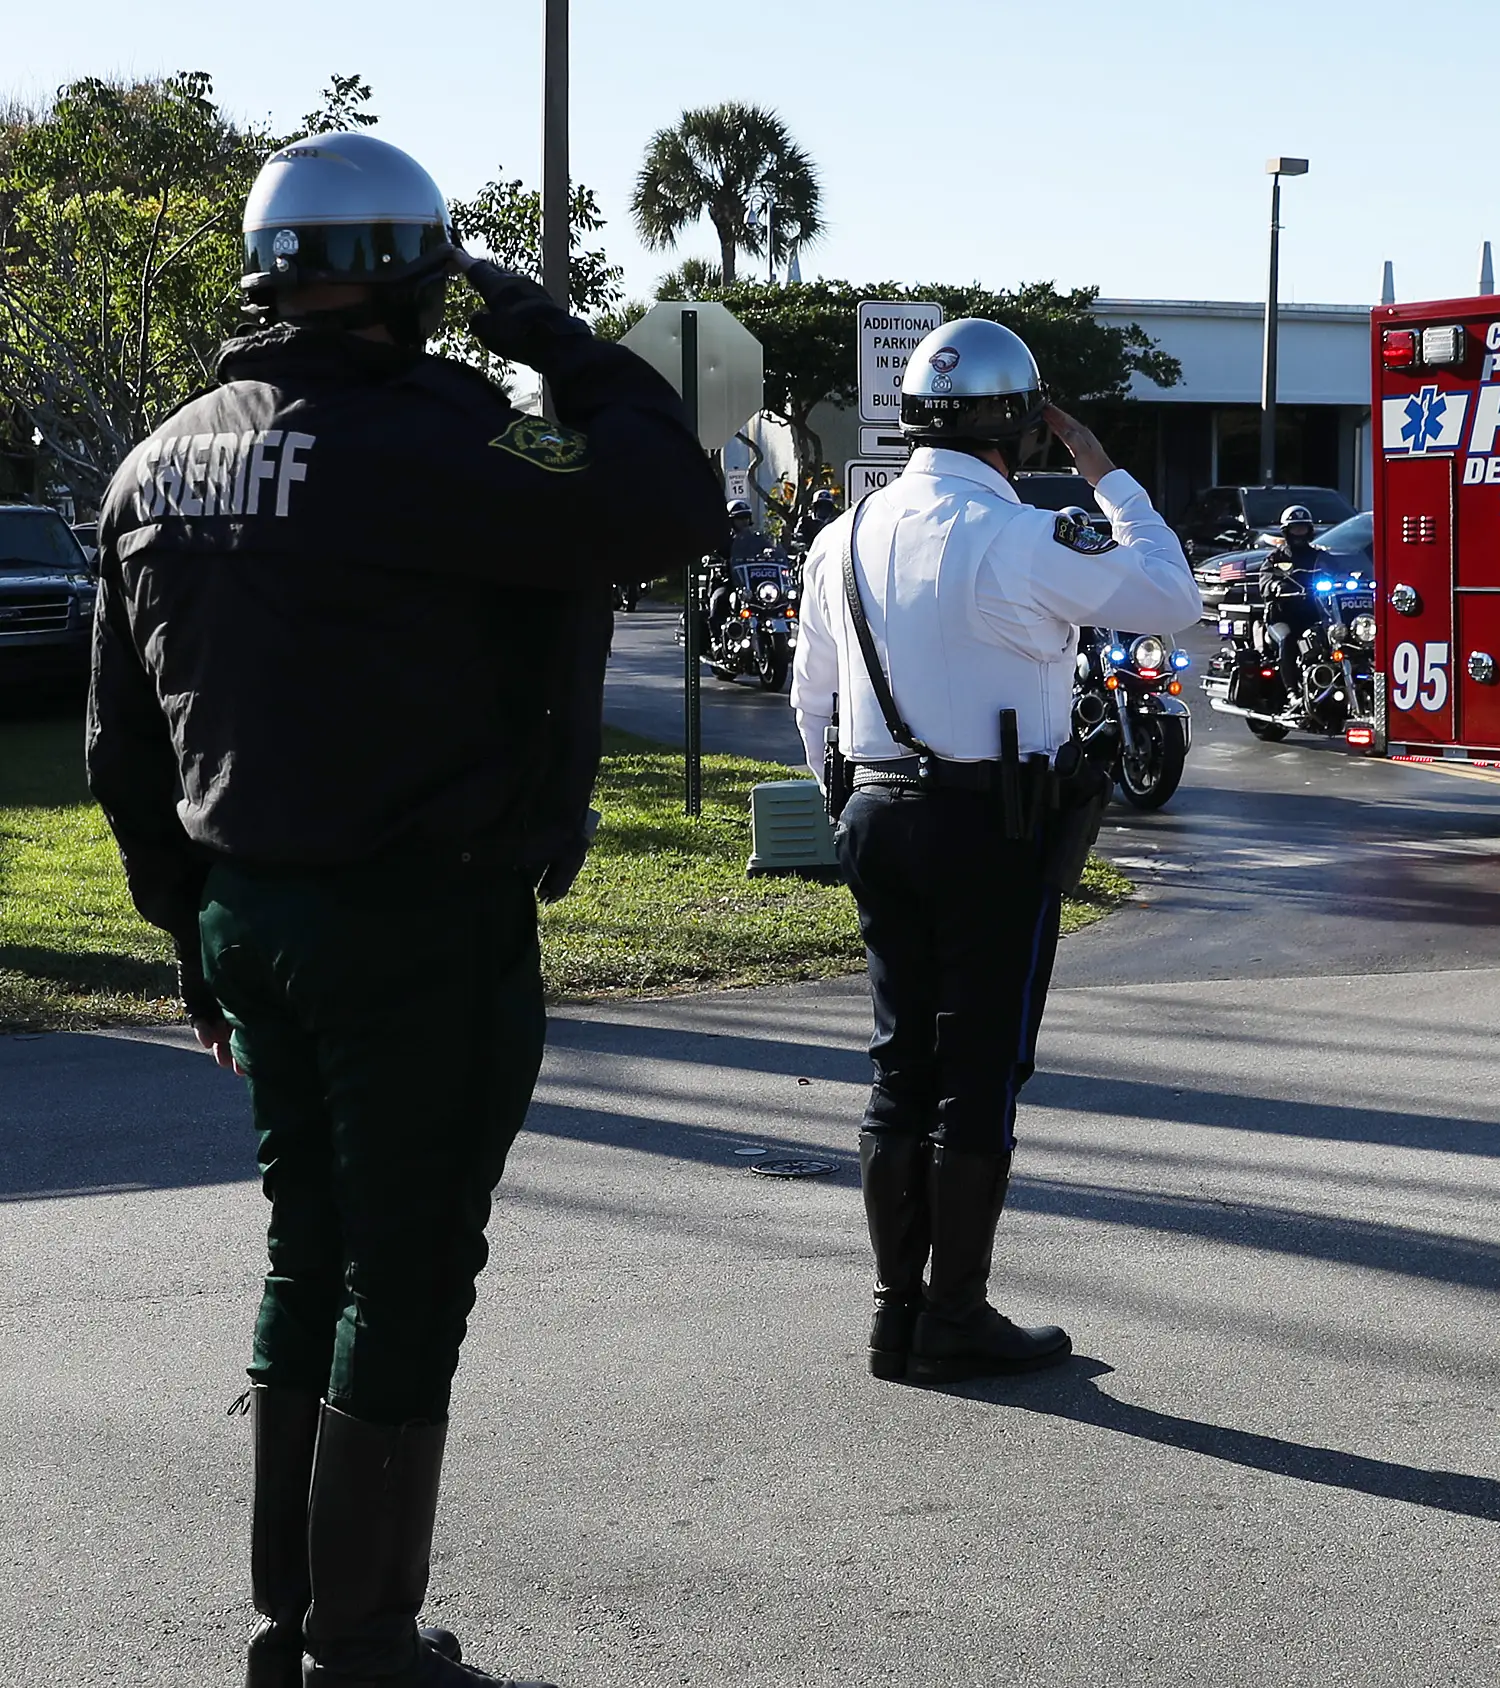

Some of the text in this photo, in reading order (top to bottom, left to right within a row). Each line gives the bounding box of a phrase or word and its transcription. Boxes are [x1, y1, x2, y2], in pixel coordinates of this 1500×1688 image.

[863, 317, 937, 330] ADDITIONAL
[874, 337, 923, 349] PARKIN
[876, 356, 908, 368] IN BA
[893, 375, 904, 387] O
[873, 394, 900, 406] BUIL
[924, 400, 960, 409] MTR 5
[135, 430, 316, 523] SHERIFF
[865, 471, 887, 487] NO
[732, 485, 744, 494] 15
[1059, 520, 1070, 539] POL
[750, 570, 777, 578] POLICE
[1341, 600, 1373, 610] POLICE
[1393, 641, 1449, 711] 95
